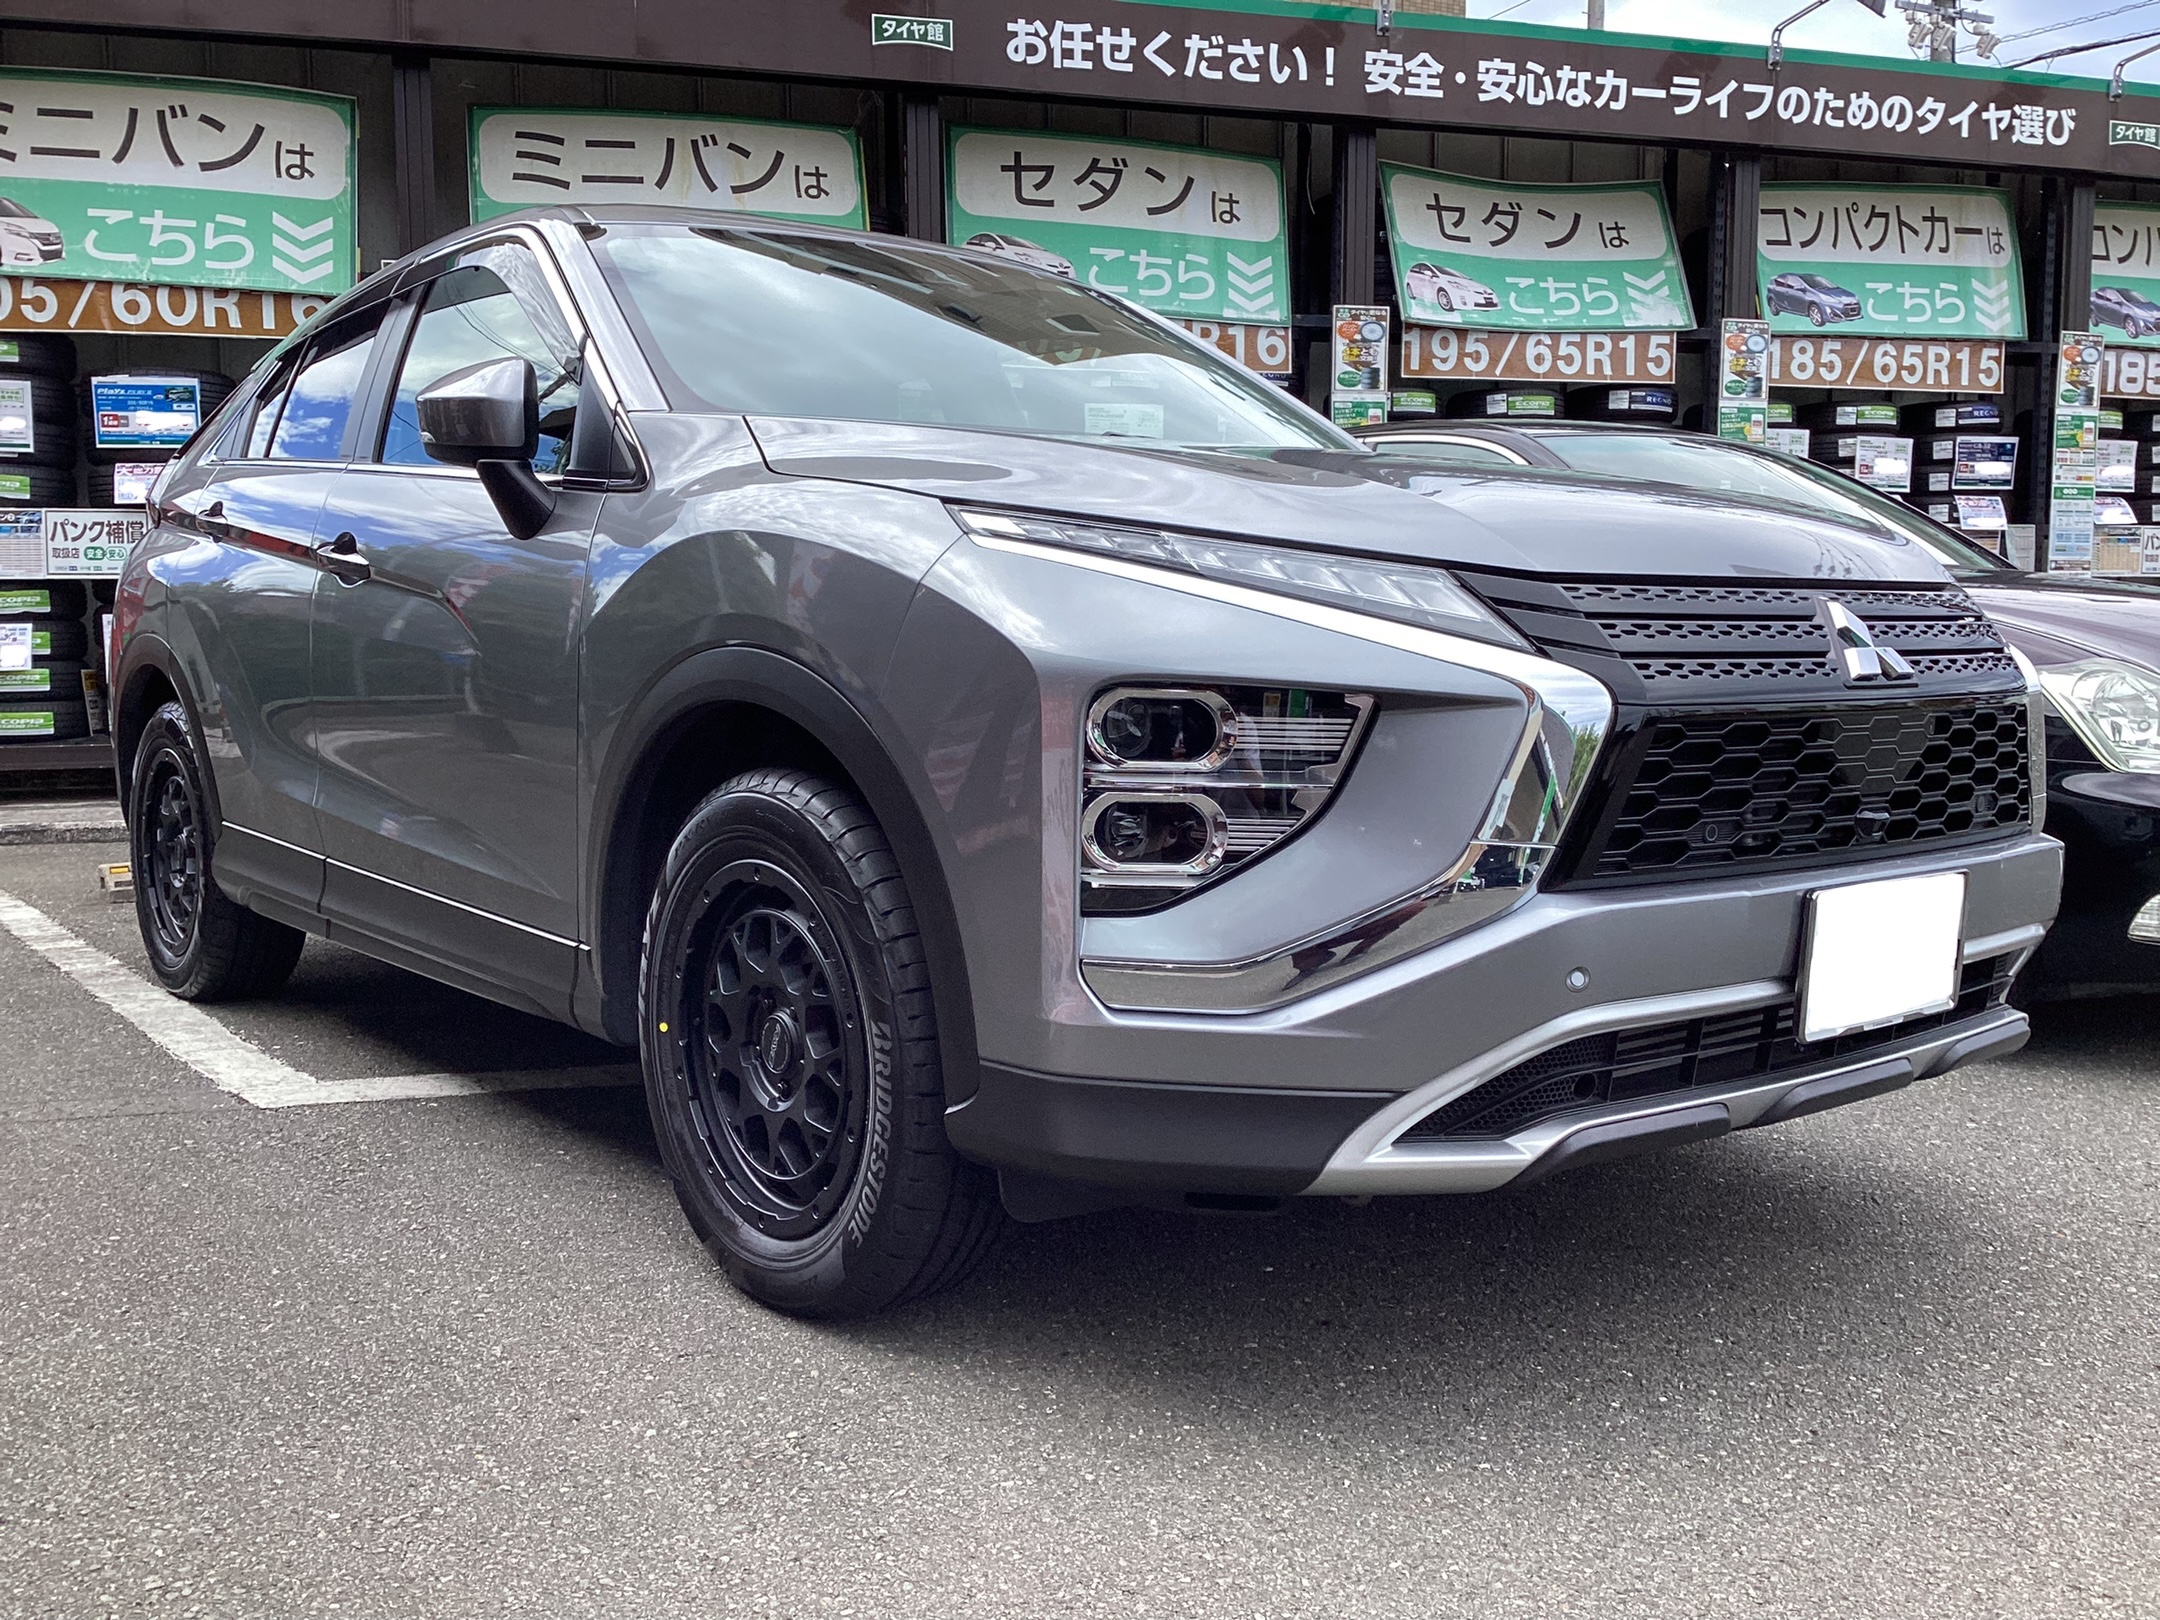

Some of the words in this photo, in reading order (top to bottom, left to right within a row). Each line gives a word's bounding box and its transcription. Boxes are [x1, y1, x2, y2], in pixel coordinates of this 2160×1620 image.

[882, 20, 944, 42] タイヤ館
[1006, 18, 1335, 86] お任せください！
[0, 102, 315, 180] ニバンは
[2115, 125, 2157, 143] タイヤ館
[511, 130, 831, 199] ミニバンは
[1000, 151, 1241, 224] セダンは
[85, 209, 255, 269] こちら
[1426, 193, 1630, 249] セダンは
[1760, 202, 2006, 255] コンパクトカーは
[1088, 247, 1216, 300] こちら
[1505, 276, 1619, 316] こちら
[1865, 282, 1966, 323] こちら
[1404, 328, 1672, 377] 195/65R15
[1768, 341, 2000, 387] 185/65R15
[1646, 396, 1672, 404] REGNO
[49, 518, 144, 544] パンク補償
[848, 1020, 895, 1248] BRIDGESTONE
